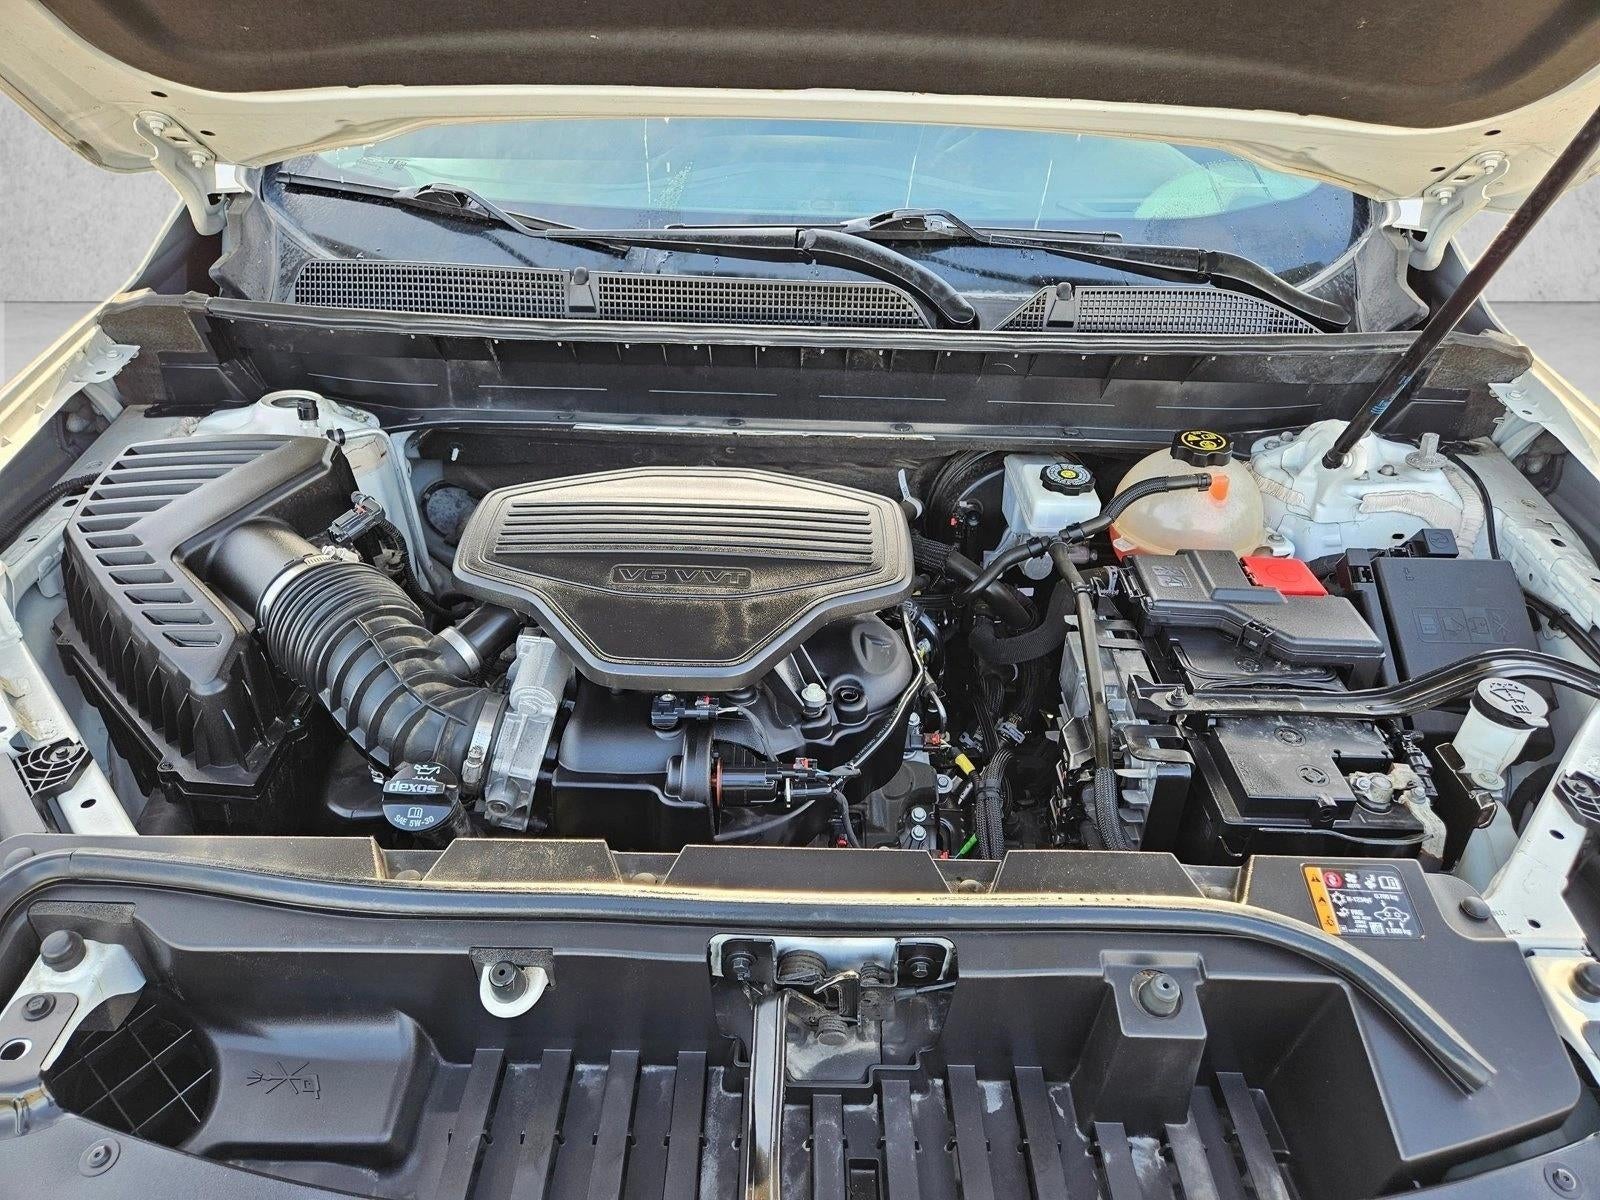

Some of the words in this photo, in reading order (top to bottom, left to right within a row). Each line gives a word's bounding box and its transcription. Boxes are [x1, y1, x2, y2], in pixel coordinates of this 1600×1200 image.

[618, 568, 667, 581] V6
[675, 569, 746, 584] VVT
[389, 780, 439, 794] dexos
[394, 815, 408, 826] SAE
[409, 815, 435, 827] 5W-30
